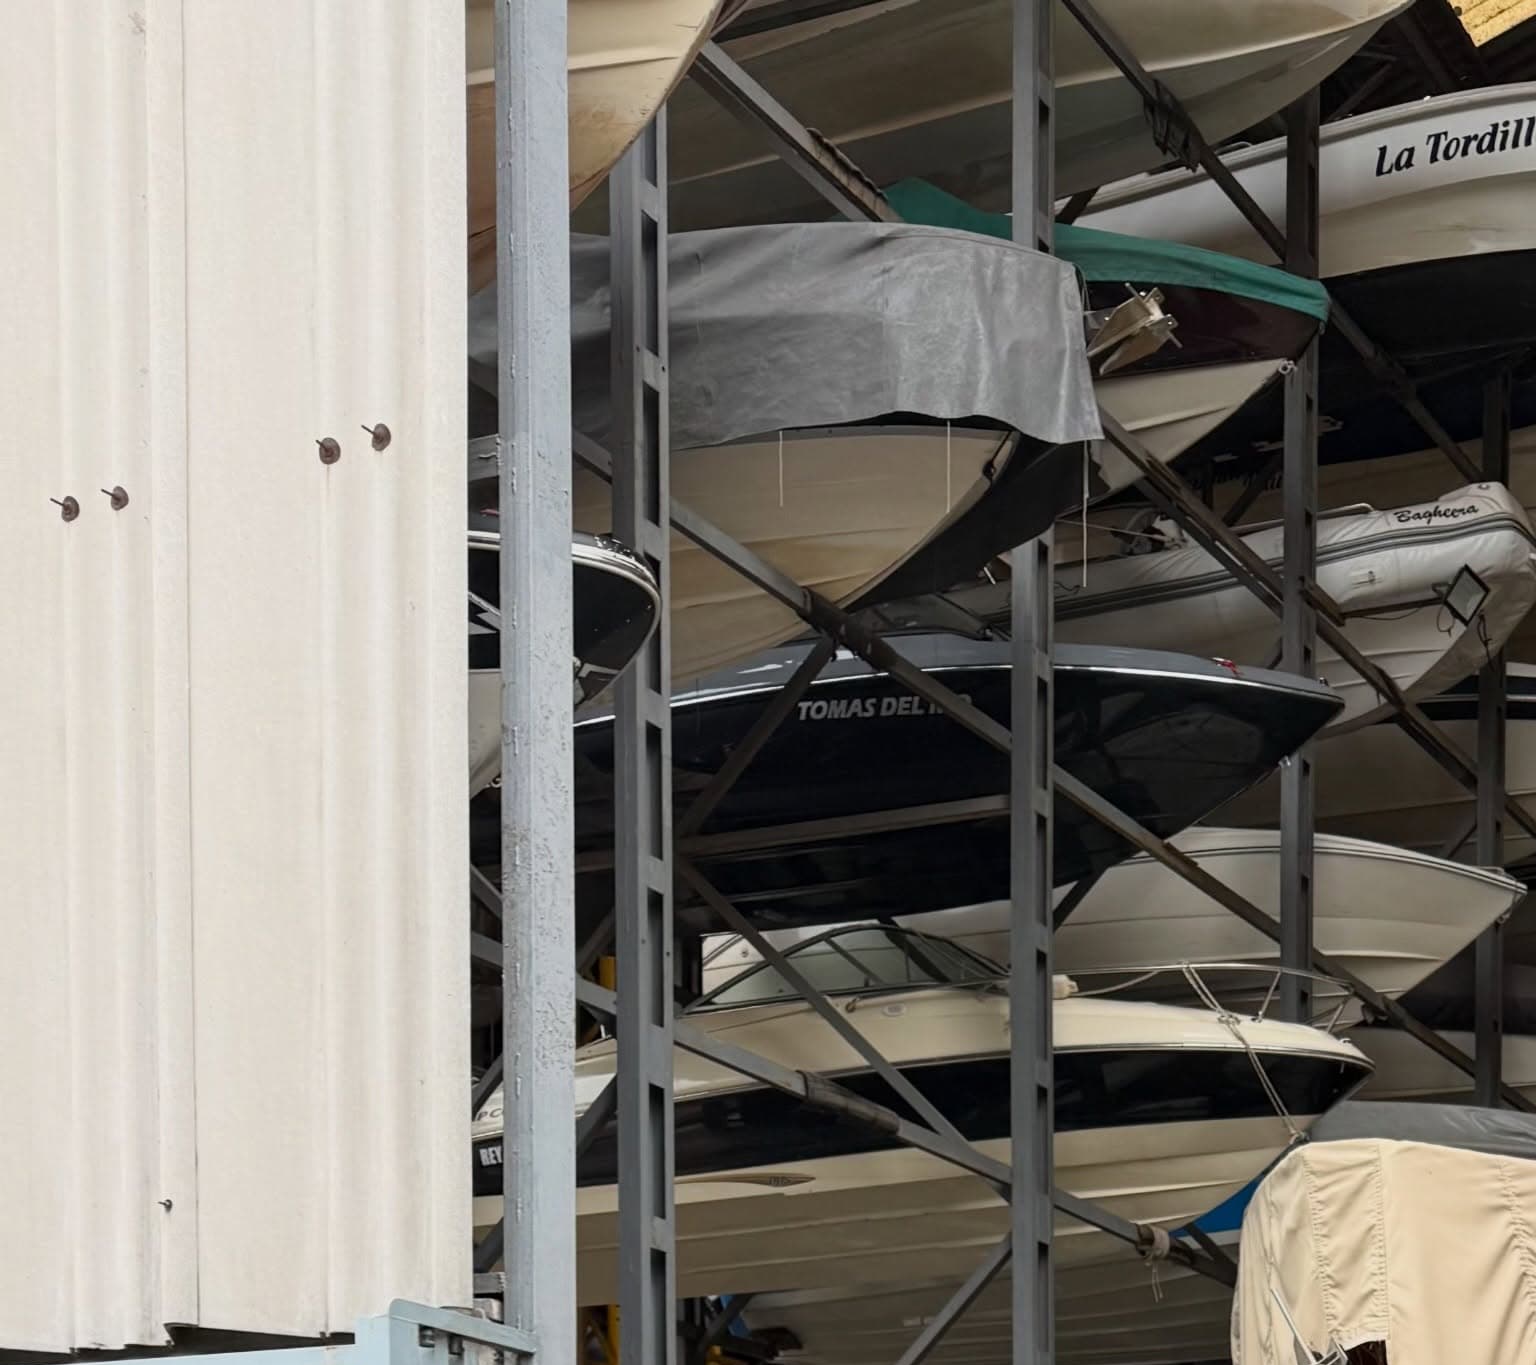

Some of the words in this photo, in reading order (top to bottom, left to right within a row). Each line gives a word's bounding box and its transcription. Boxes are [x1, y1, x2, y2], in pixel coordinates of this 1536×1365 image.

[1375, 145, 1416, 177] La
[1393, 503, 1480, 525] Bagheera
[797, 698, 877, 721] TOMAS
[880, 696, 925, 717] DEL
